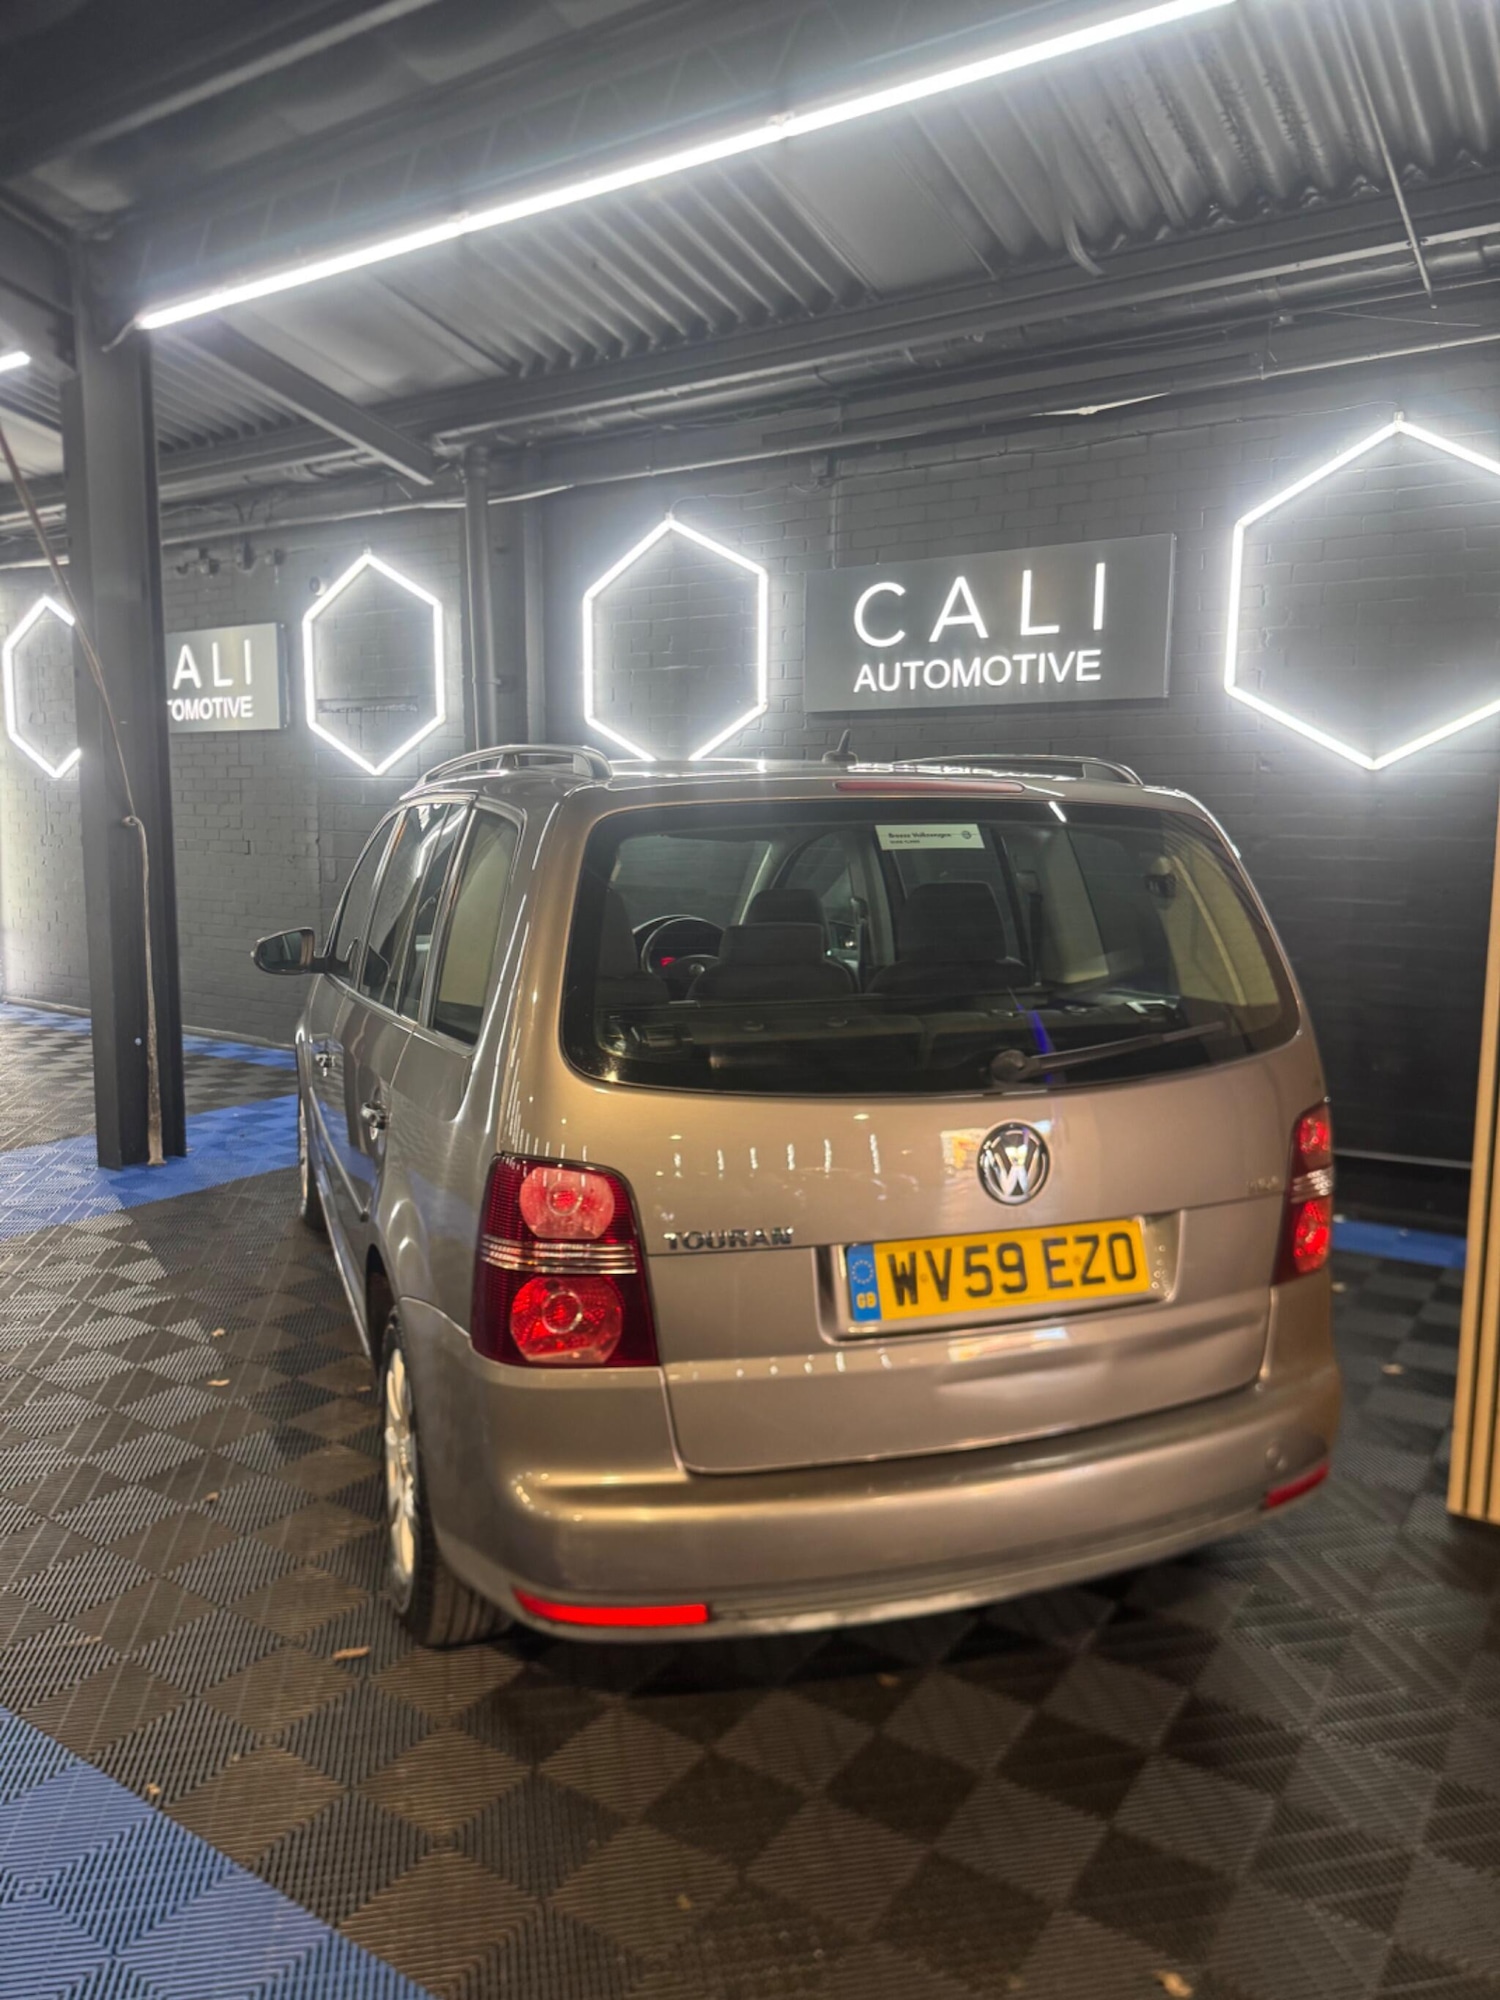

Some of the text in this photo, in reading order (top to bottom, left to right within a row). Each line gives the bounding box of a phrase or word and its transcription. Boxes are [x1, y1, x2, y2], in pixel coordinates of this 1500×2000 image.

[854, 562, 1105, 647] CALI
[172, 639, 252, 690] ALI
[853, 649, 1102, 692] AUTOMOTIVE
[167, 695, 254, 721] OMOTIVE
[663, 1226, 794, 1251] TOURAN
[887, 1232, 1138, 1307] WV59 EZO
[856, 1291, 877, 1309] GB
